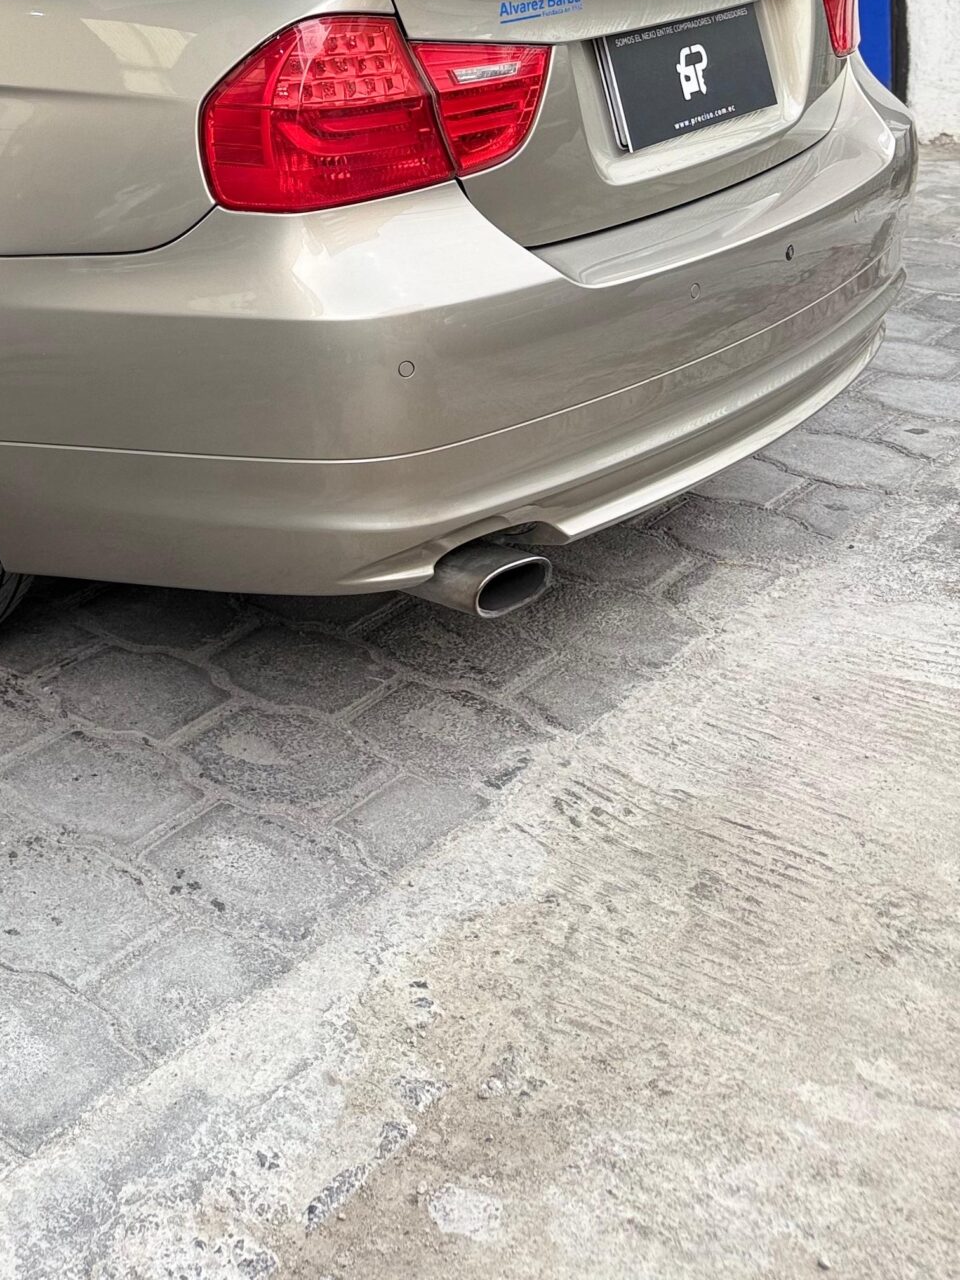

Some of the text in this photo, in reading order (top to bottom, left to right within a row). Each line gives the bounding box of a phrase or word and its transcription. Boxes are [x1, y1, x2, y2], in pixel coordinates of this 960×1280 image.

[500, 0, 545, 17] Alvarez
[615, 36, 636, 47] SOMOS
[642, 30, 656, 41] NEXO
[657, 26, 674, 37] ENTRE
[674, 105, 736, 130] www.preciso.com.ec
